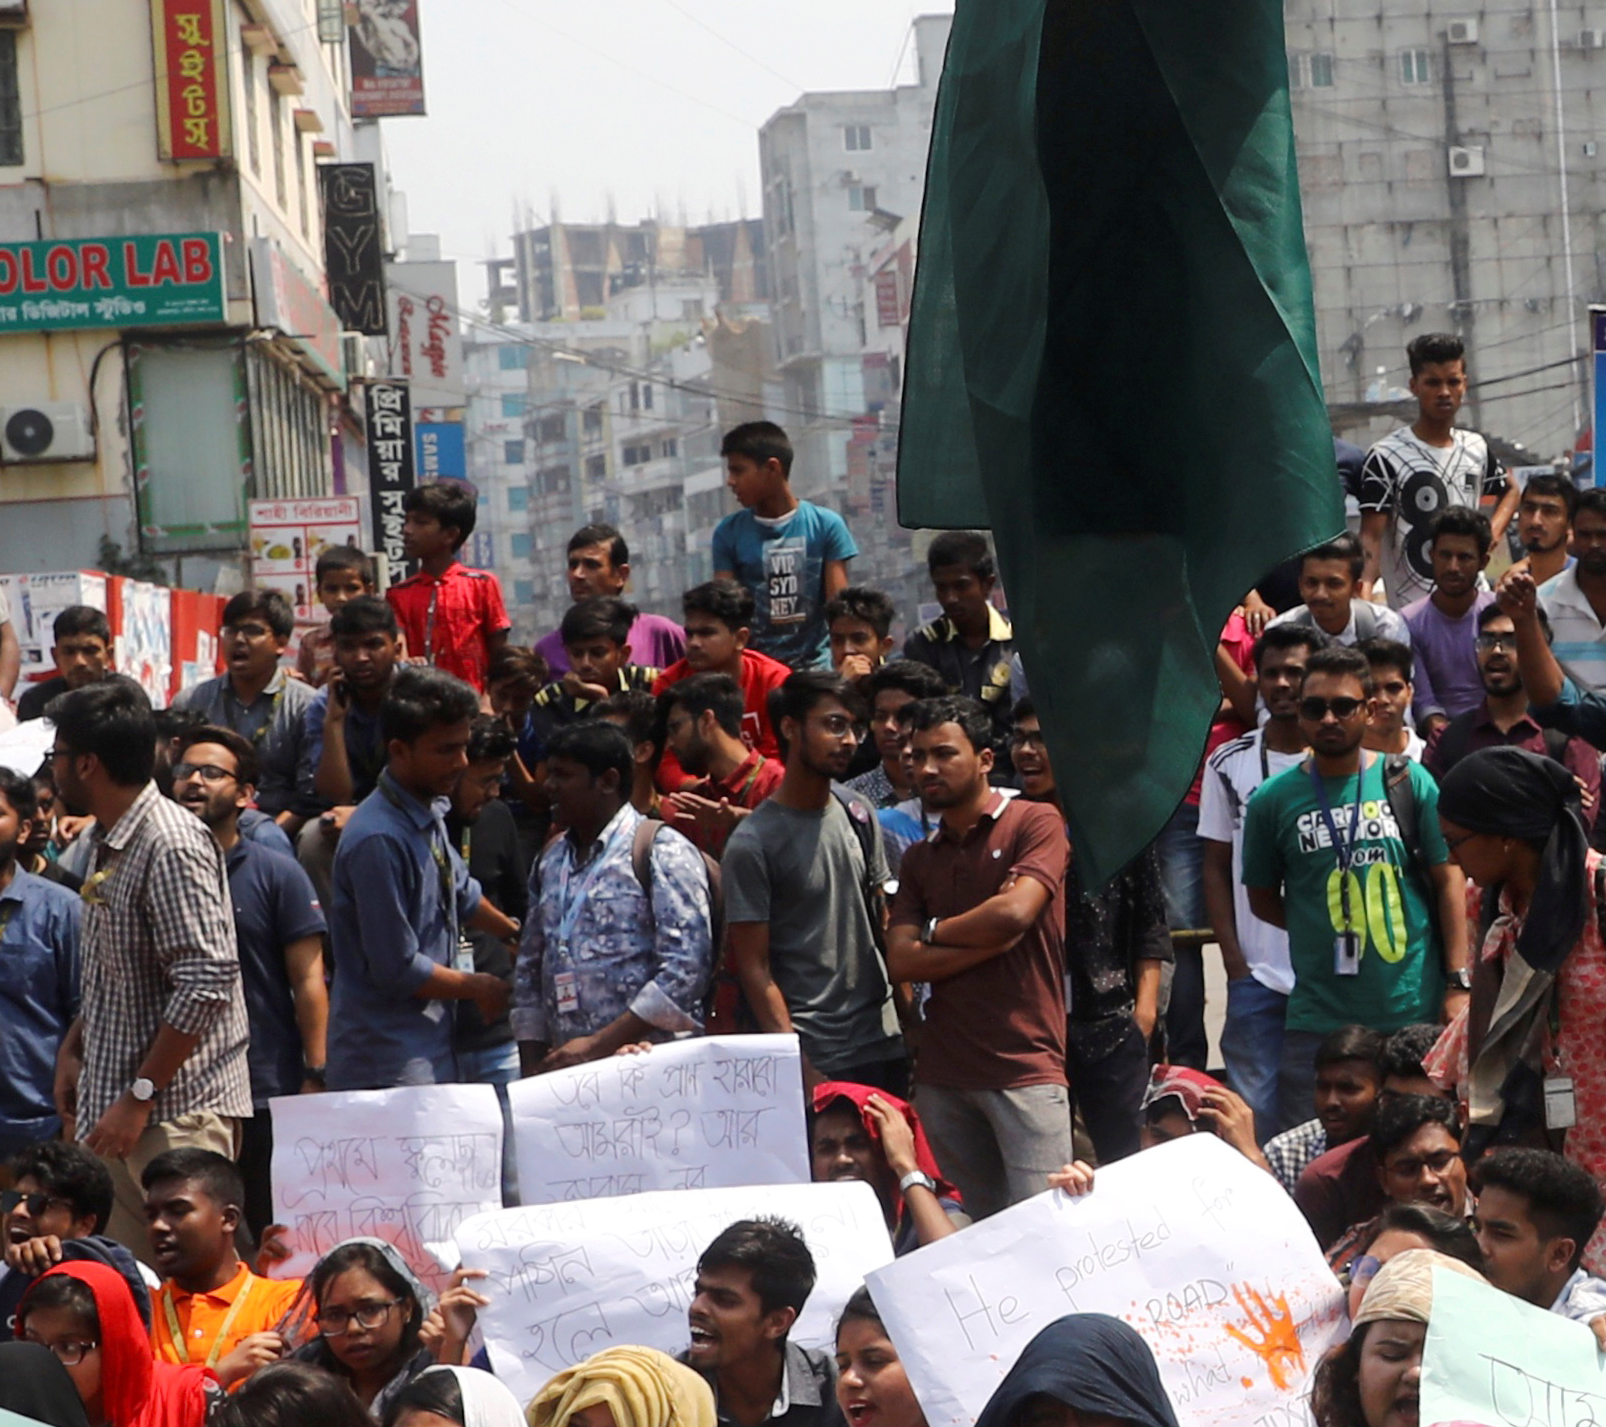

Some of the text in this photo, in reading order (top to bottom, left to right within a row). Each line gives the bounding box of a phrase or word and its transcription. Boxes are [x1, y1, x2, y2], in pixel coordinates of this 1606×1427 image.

[121, 237, 213, 288] LAB
[769, 555, 796, 575] VIP
[769, 575, 799, 596] SYD
[769, 596, 799, 616] NEY
[943, 1273, 1031, 1351] He
[1054, 1205, 1172, 1312] protested
